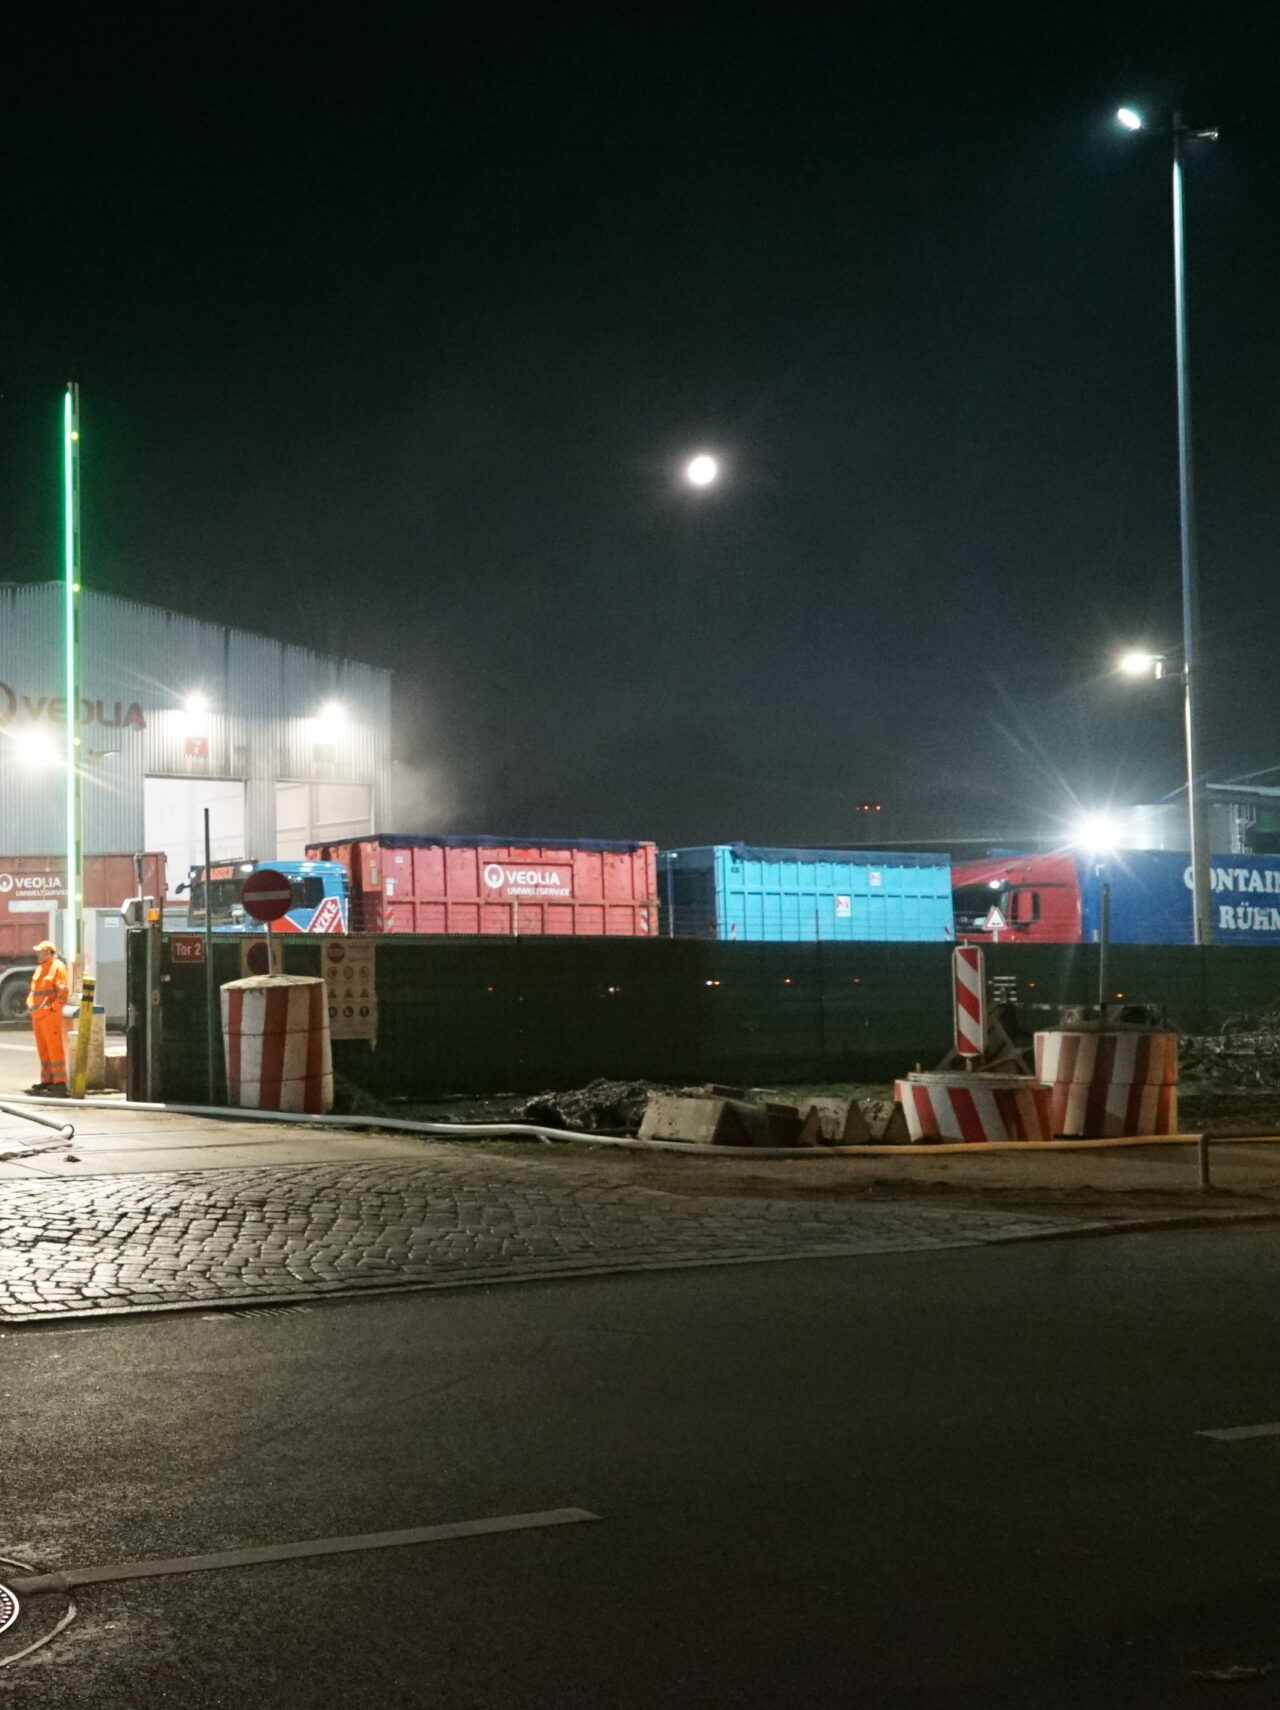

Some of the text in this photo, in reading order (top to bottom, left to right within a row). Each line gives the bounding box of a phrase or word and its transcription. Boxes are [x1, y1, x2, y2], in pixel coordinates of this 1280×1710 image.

[15, 876, 62, 889] VEOLIA
[503, 870, 560, 885] VEOLIA
[15, 889, 68, 897] UMWELTSERVIC
[175, 942, 201, 956] Tor 2
